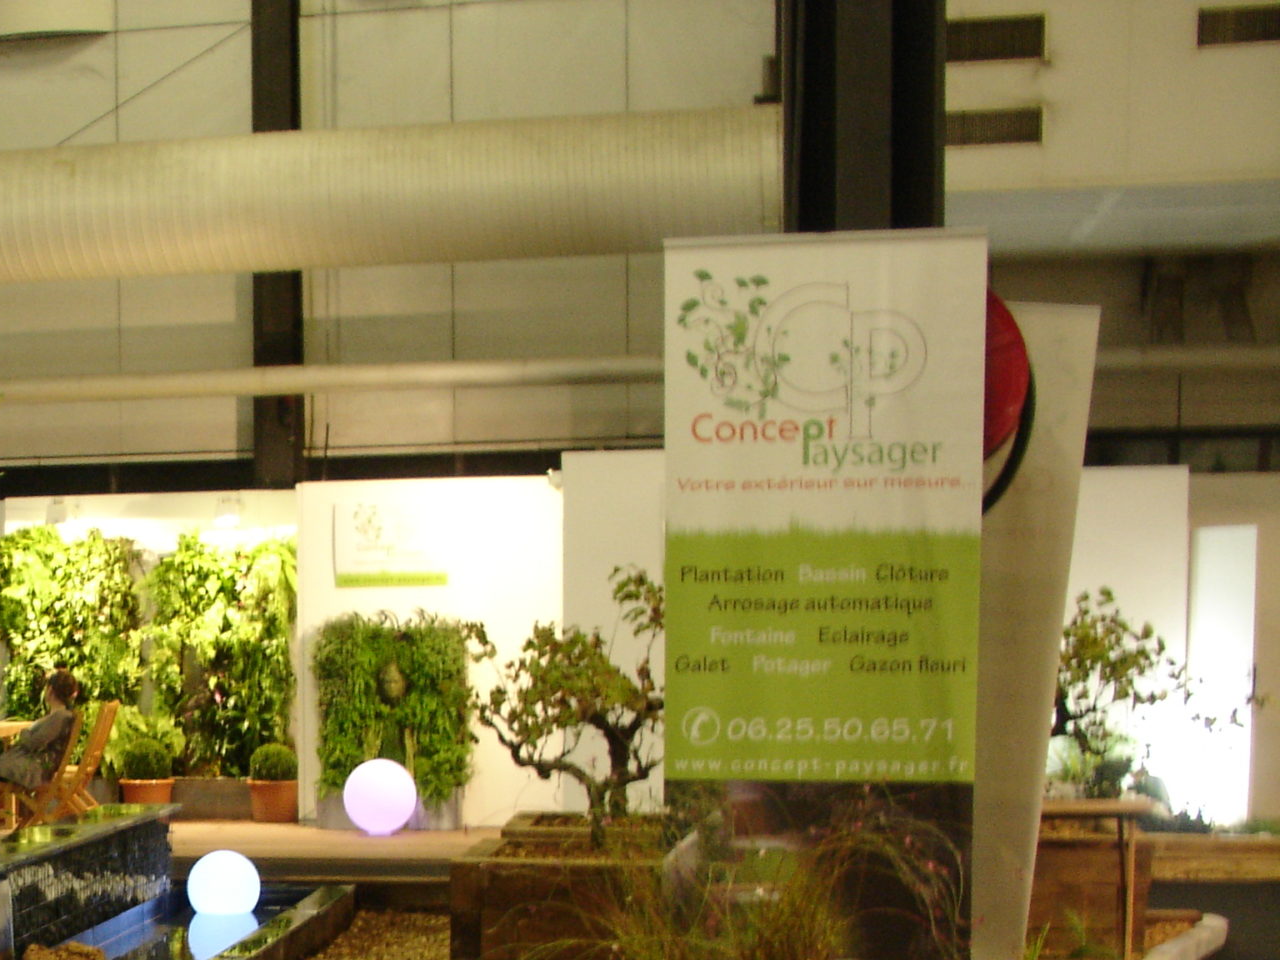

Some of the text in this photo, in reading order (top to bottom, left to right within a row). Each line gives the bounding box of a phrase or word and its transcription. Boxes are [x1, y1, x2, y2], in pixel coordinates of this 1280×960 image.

[690, 413, 838, 444] Concept
[801, 419, 944, 473] Paysager
[677, 477, 736, 492] Votre
[740, 474, 837, 491] extérieur
[843, 475, 877, 489] sur
[680, 562, 949, 583] Plantation Bassin Clôture
[707, 593, 933, 617] Arrosage automatique
[710, 625, 910, 648] Fontaine Eclairage
[674, 654, 968, 676] Galet Potager Gazon fleuri
[726, 716, 956, 741] 06.25.50.65.71
[674, 755, 970, 779] www.concept-paysager.fr
